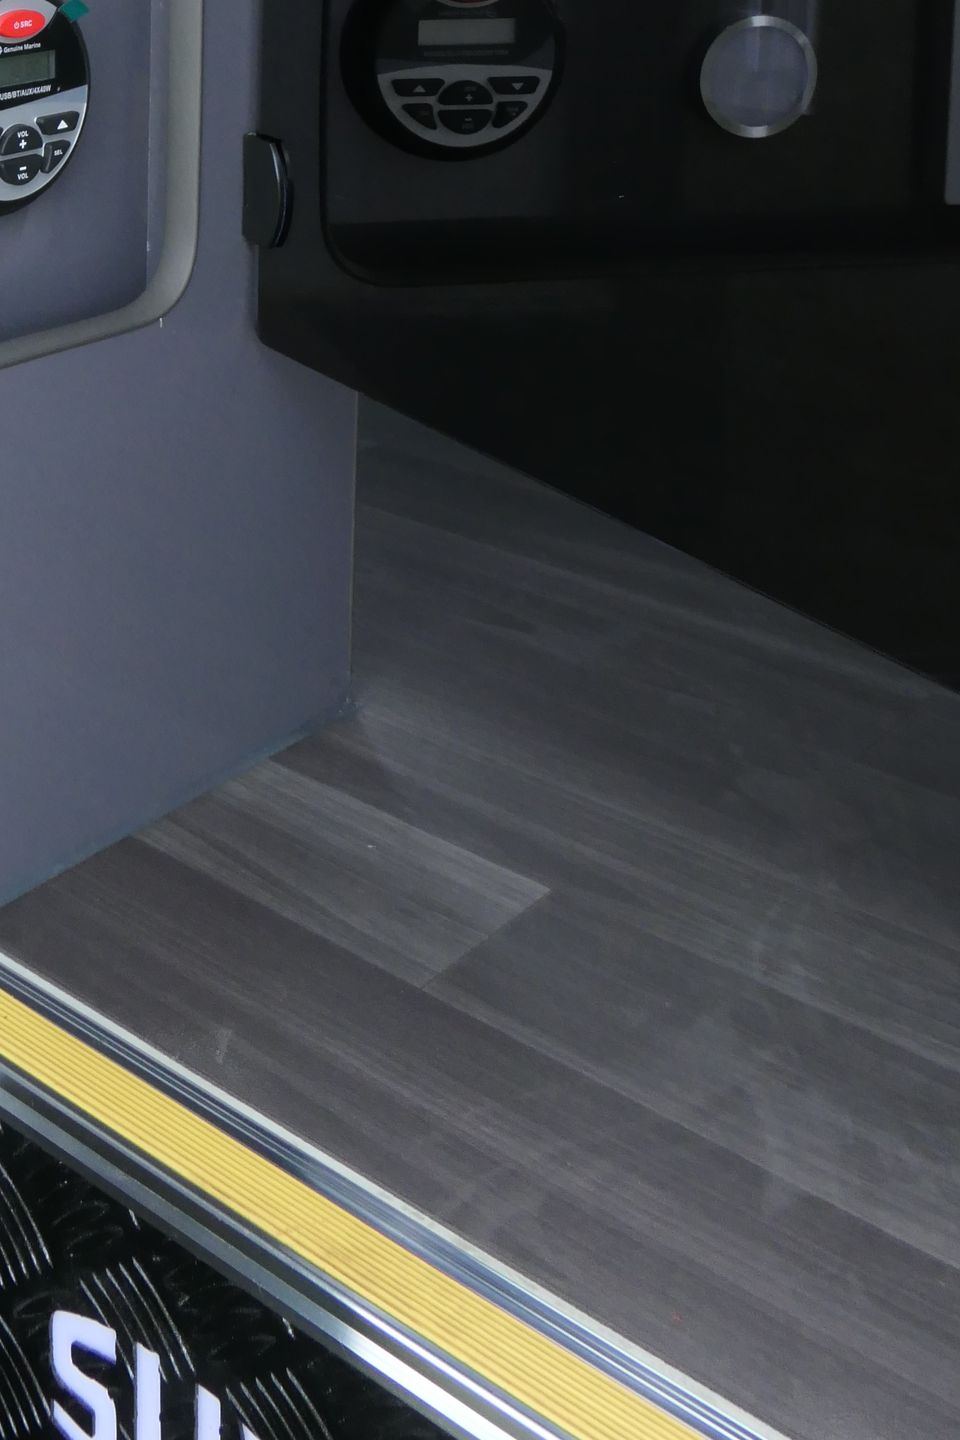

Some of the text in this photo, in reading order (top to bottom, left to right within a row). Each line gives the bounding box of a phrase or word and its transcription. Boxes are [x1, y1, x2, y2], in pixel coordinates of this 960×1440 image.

[20, 19, 33, 28] SRC
[3, 42, 41, 54] Genuine Marine
[17, 130, 29, 138] VOL
[53, 149, 63, 157] SEL
[17, 173, 29, 181] VOL
